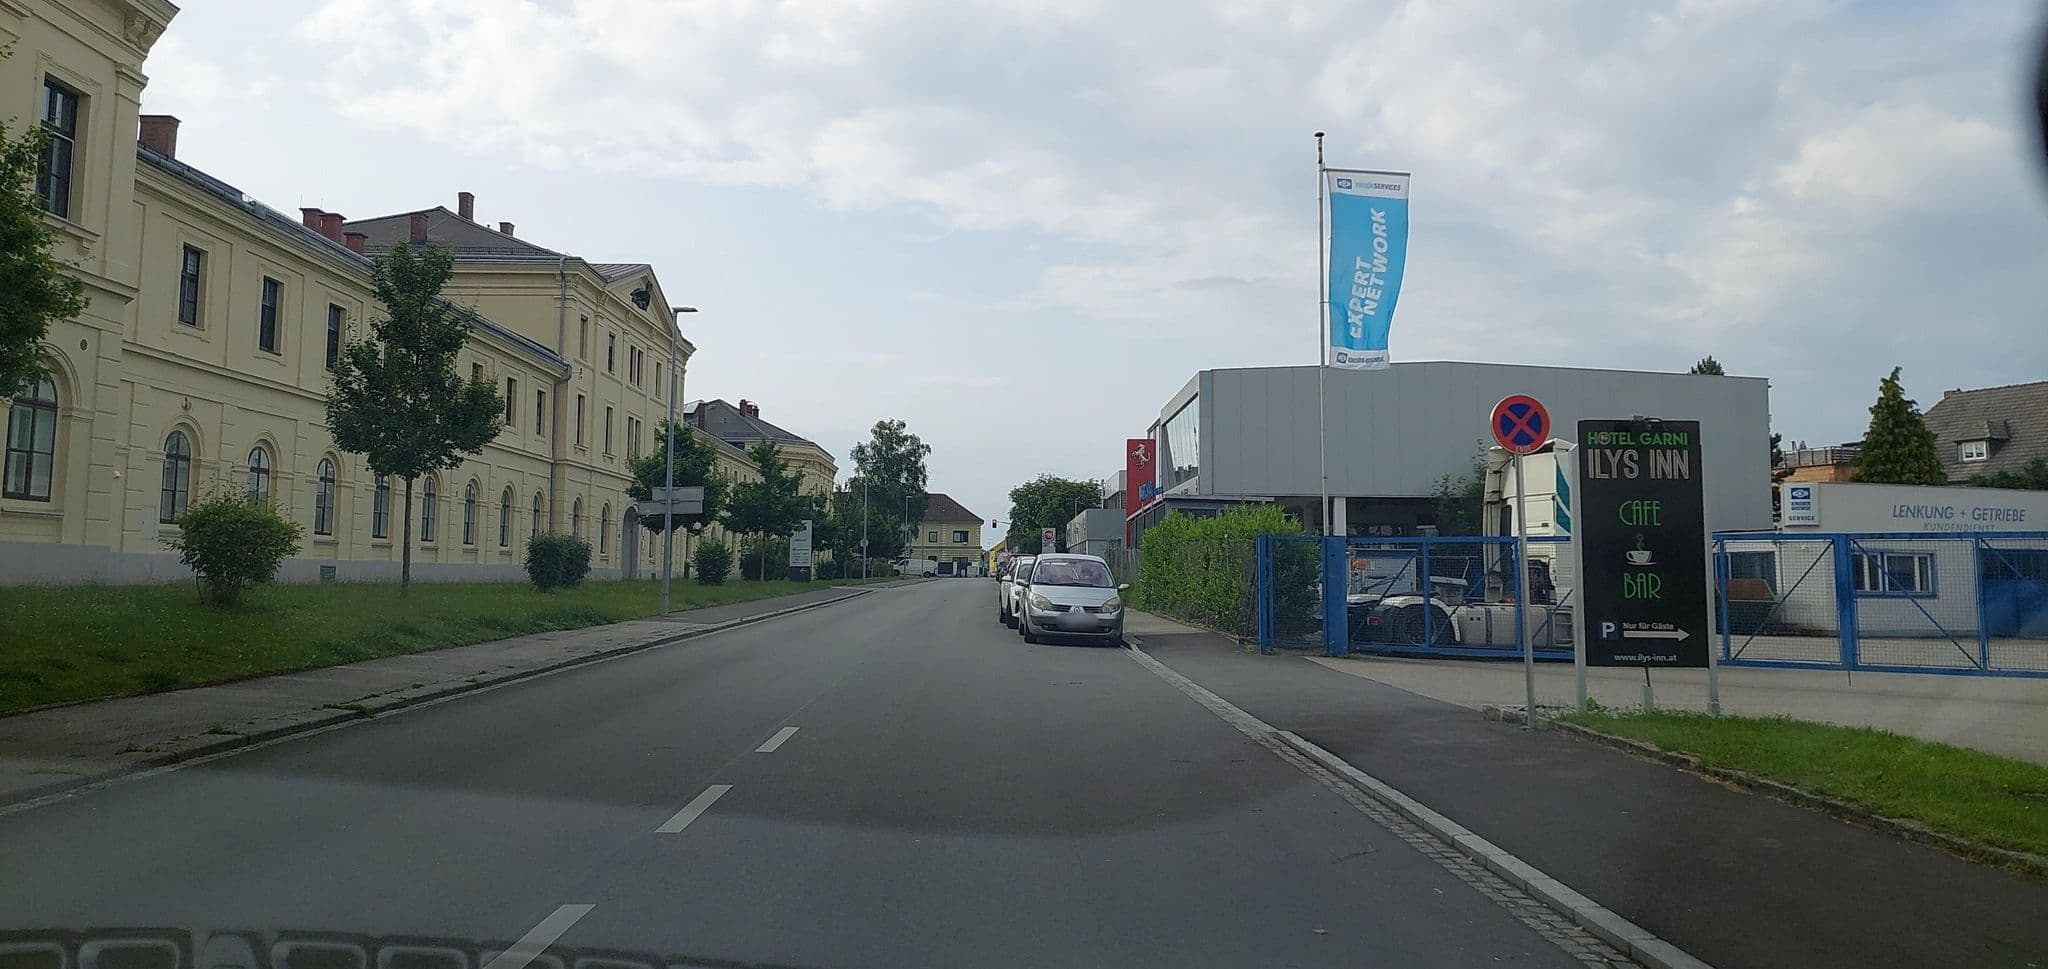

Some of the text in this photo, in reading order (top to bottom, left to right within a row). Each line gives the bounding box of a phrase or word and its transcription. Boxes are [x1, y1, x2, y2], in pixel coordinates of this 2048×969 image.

[1362, 207, 1389, 317] NETWORK
[1348, 256, 1373, 339] EXPERT
[1587, 431, 1688, 446] HOTEL GARNI
[1587, 448, 1690, 480] ILYS INN
[1619, 500, 1662, 526] CAFE
[1892, 504, 1954, 520] LENKUNG
[1972, 507, 2026, 522] GETRIEBE
[1923, 522, 1996, 532] KUNDENDIENST
[1623, 572, 1664, 599] BAR
[1601, 621, 1616, 639] P
[1622, 622, 1674, 630] Nur für Gäste
[1614, 654, 1677, 663] www.ilys-inn.at
